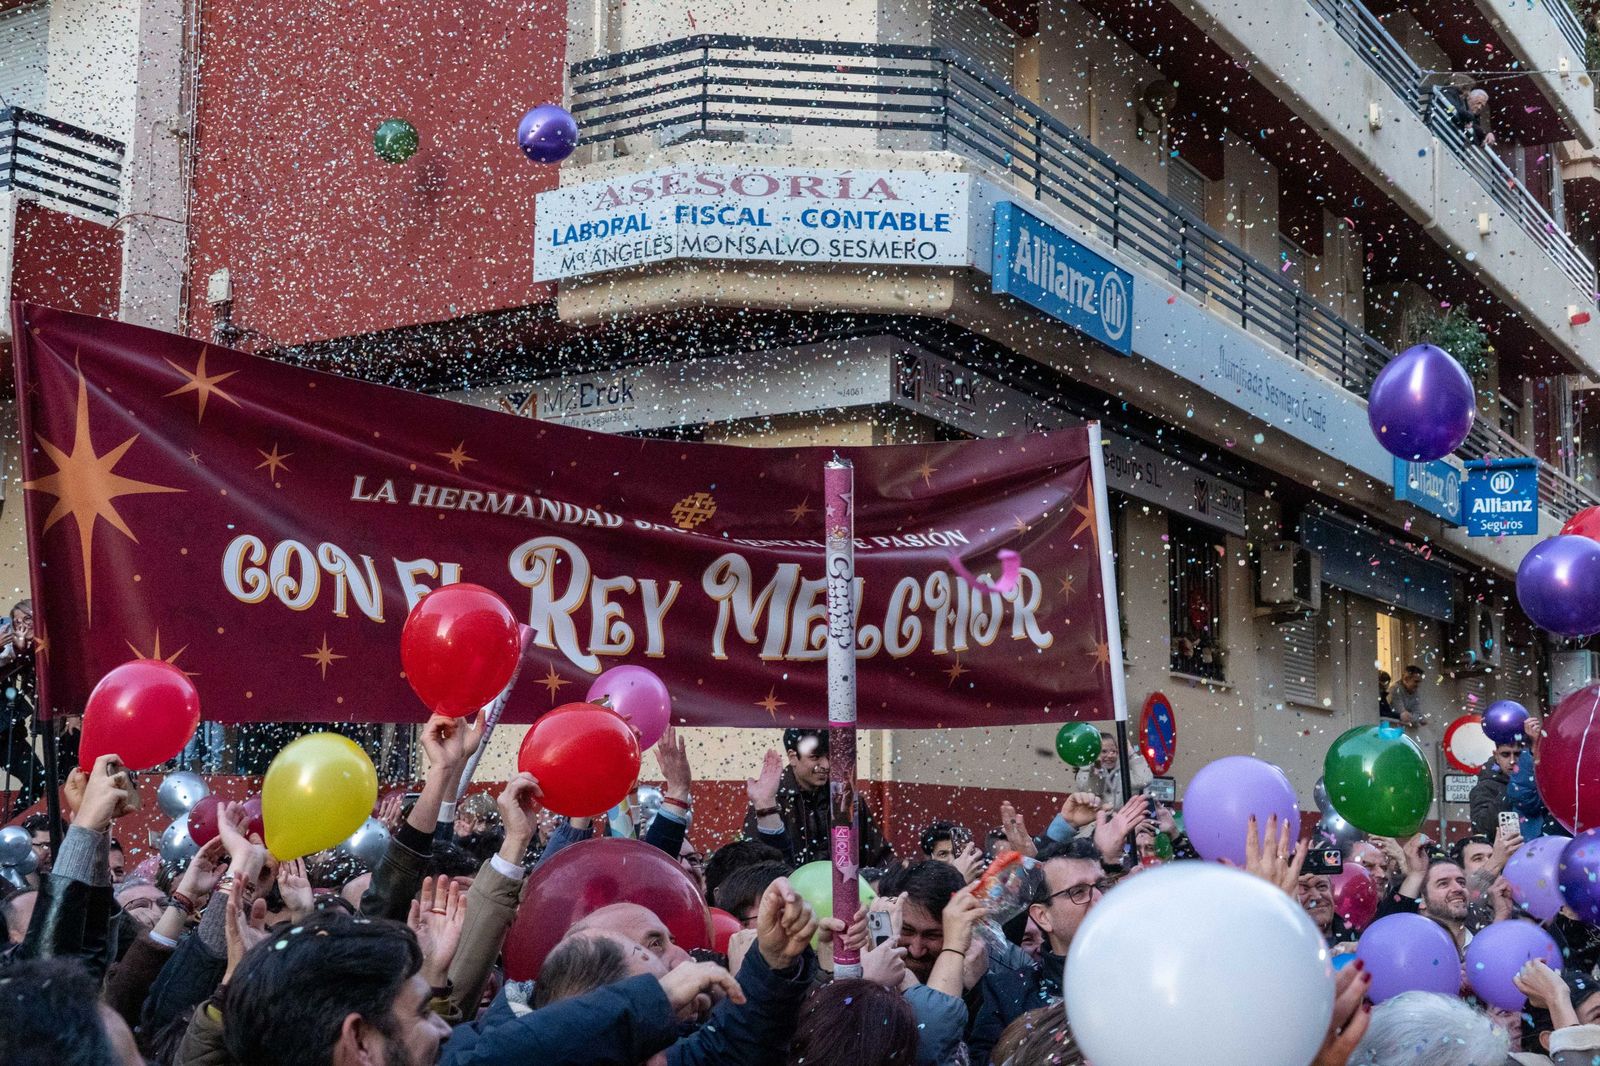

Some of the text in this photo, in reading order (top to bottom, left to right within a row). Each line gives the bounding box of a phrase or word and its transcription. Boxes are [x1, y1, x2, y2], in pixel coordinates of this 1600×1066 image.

[593, 170, 903, 212] ASESORÍA
[552, 213, 652, 247] LABORAL
[675, 205, 772, 227] FISCAL
[800, 208, 950, 233] CONTABLE
[683, 235, 819, 257] MONSALVO
[829, 238, 937, 260] SESMERO
[1014, 226, 1096, 315] Allianz
[1265, 376, 1300, 419] Sesmero
[351, 475, 398, 505] LA
[409, 483, 625, 529] HERMANDAD
[1472, 498, 1533, 514] Allianz
[1481, 519, 1523, 532] Seguros
[221, 534, 386, 624] CON
[508, 536, 681, 674] REY
